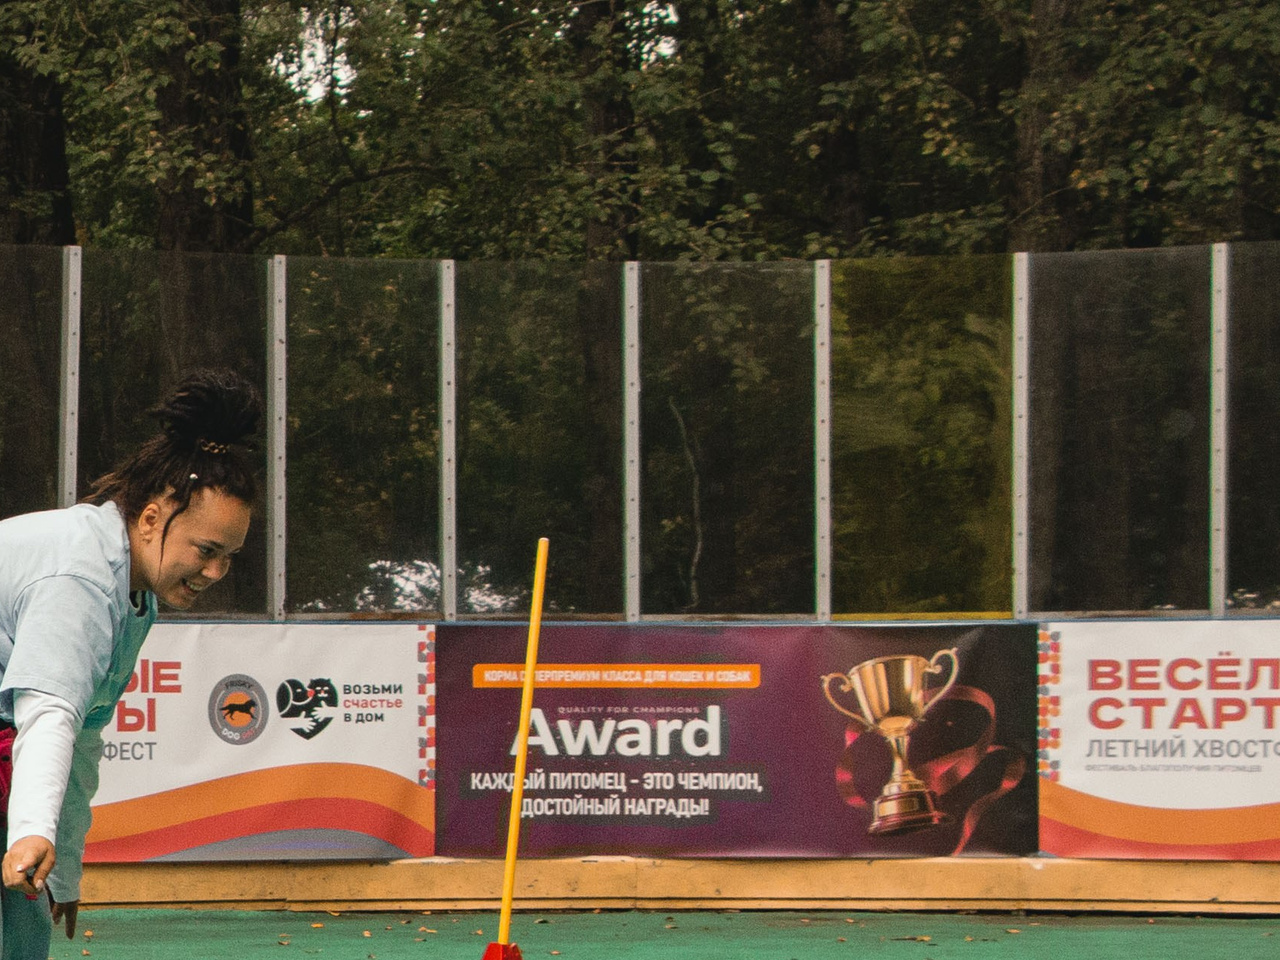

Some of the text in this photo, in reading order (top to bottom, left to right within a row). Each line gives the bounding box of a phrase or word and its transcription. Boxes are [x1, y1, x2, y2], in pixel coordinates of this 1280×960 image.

[1088, 651, 1280, 690] ВЕСЁЛ
[343, 698, 403, 709] счастье
[558, 706, 700, 714] QUALITY FOR CHAMPIONS
[1088, 697, 1280, 730] СТАРТ
[222, 728, 241, 740] DOG
[510, 705, 722, 756] Award
[1086, 734, 1186, 758] ЛЕТНИЙ
[471, 768, 546, 793] КАЖДЫЙ
[549, 772, 627, 793] ПИТОМЕЦ
[643, 772, 675, 790] ЭТО
[677, 772, 763, 793] ЧЕМПИОН,
[521, 794, 710, 818] ДОСТОЙНЫЙ НАГРАДЫ!
